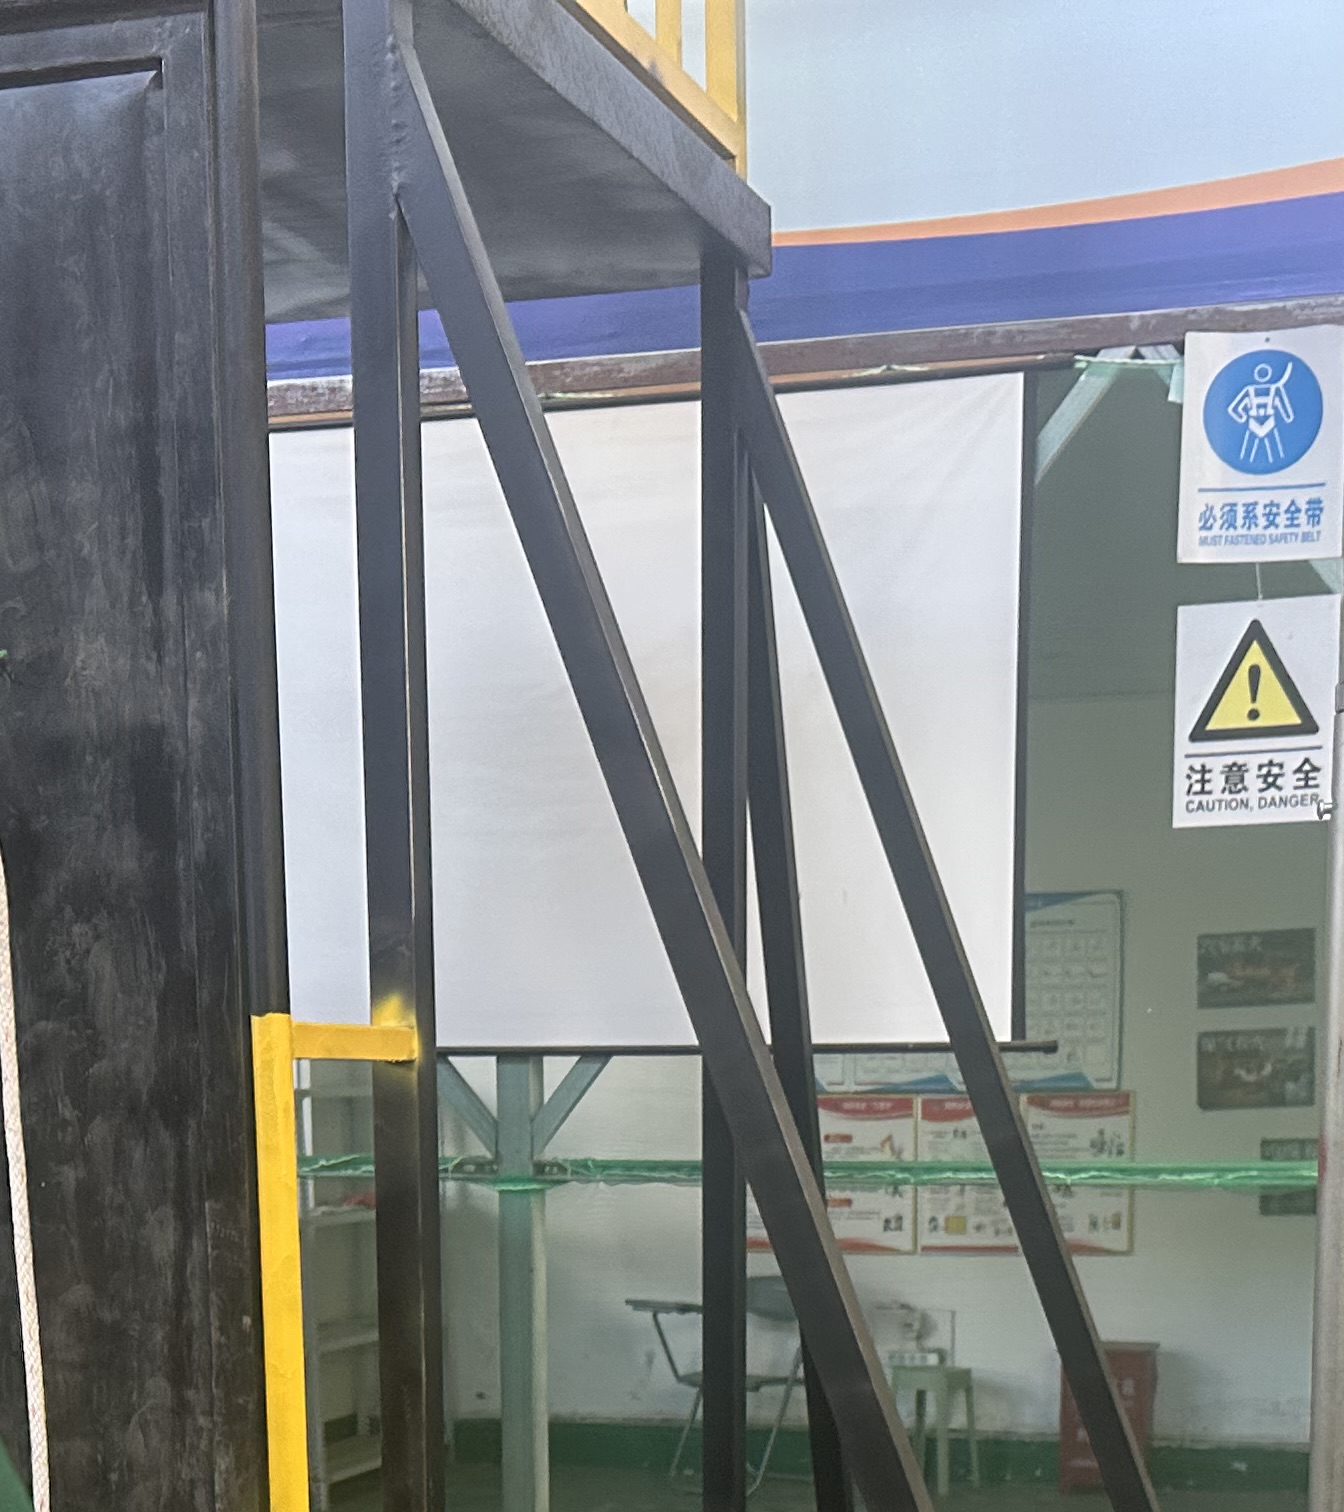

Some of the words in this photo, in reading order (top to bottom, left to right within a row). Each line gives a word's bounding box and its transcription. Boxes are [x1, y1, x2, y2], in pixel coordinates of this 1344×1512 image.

[1198, 497, 1324, 531] 必须系安全带
[1269, 532, 1299, 544] SAFETY
[1301, 531, 1321, 543] BELT
[1185, 757, 1322, 796] 注意安全
[1185, 798, 1254, 813] CAUTION,
[1258, 793, 1319, 809] DANGER
